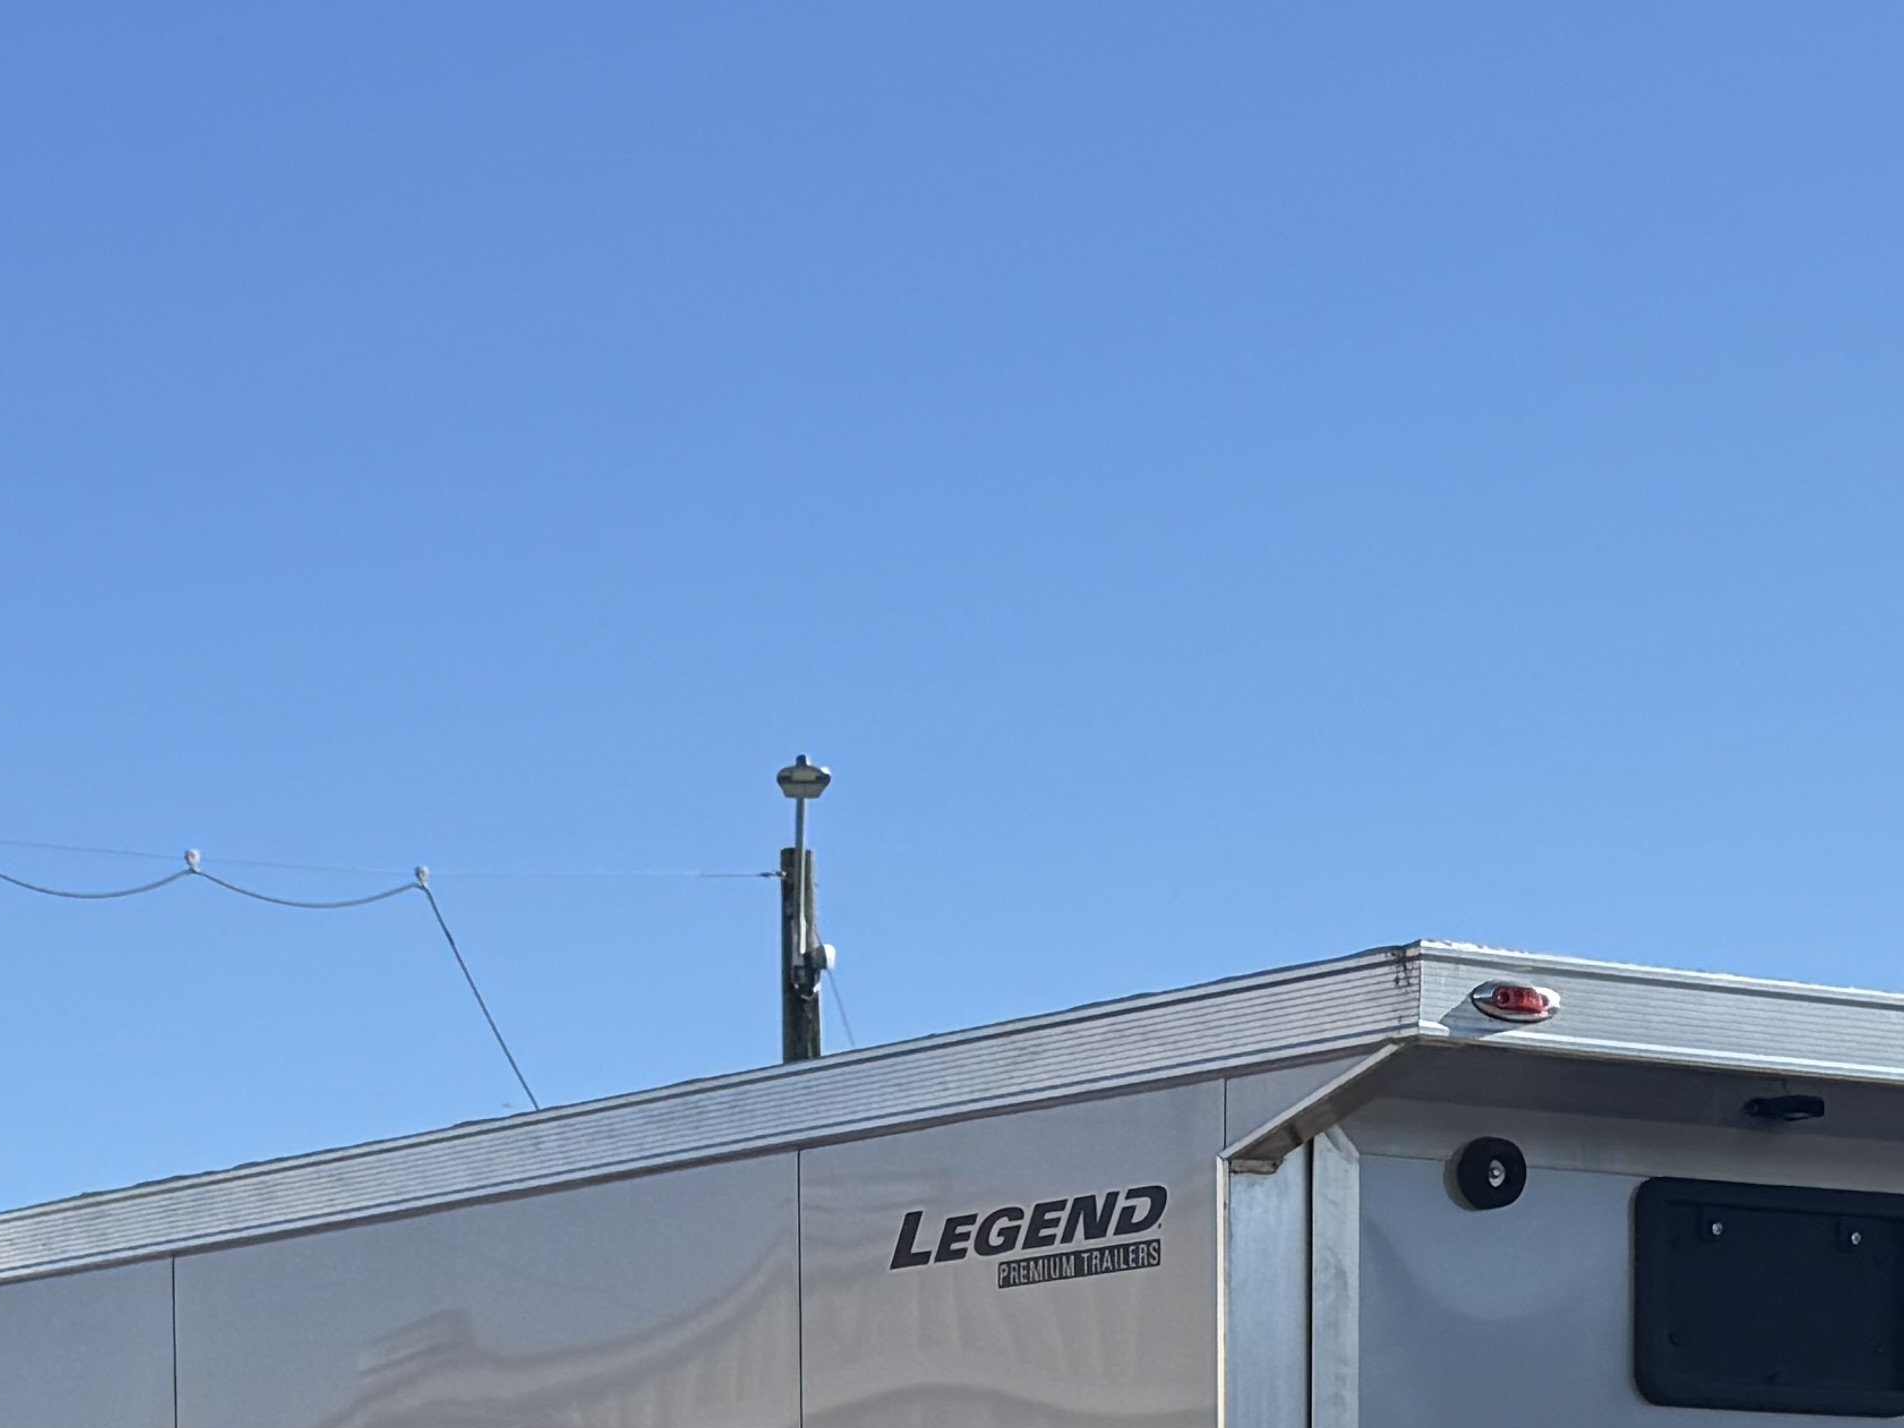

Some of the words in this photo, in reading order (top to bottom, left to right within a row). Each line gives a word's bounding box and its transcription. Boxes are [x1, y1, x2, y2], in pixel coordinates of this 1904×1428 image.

[890, 1185, 1168, 1270] LEGEND
[999, 1255, 1075, 1286] PREMIUM
[1081, 1243, 1160, 1273] TRAILERS
